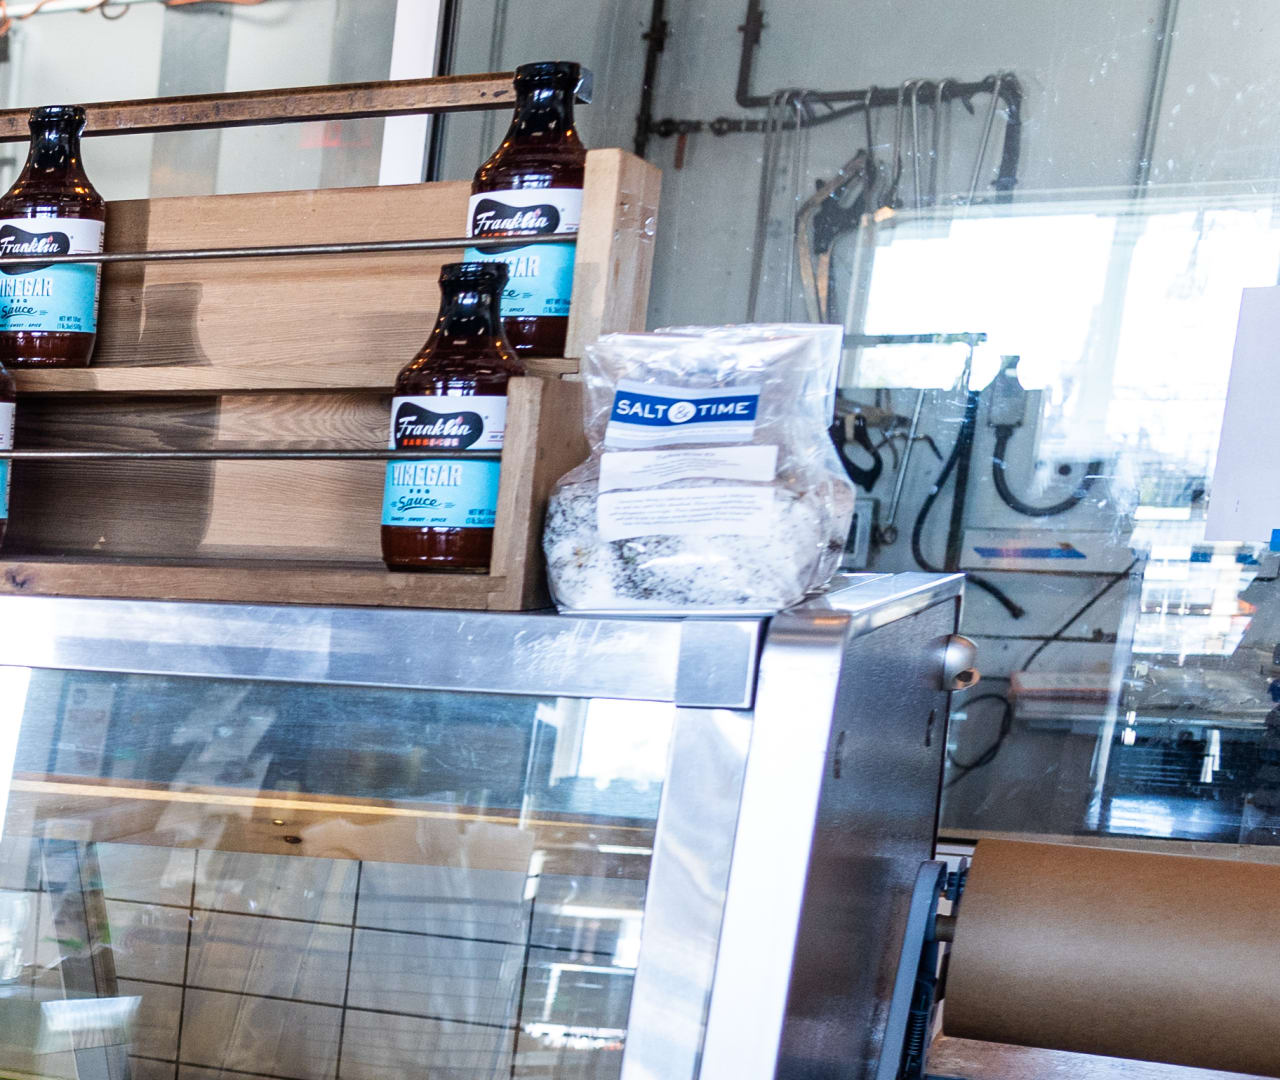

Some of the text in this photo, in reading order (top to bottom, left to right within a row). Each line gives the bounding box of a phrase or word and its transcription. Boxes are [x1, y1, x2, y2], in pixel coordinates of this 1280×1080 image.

[474, 210, 549, 235] Franklin
[1, 306, 37, 320] Sauce
[616, 400, 668, 418] SALT
[698, 401, 753, 416] TIME
[396, 416, 472, 439] Franklin
[392, 464, 463, 487] VINEGAR
[397, 496, 441, 512] Sauce
